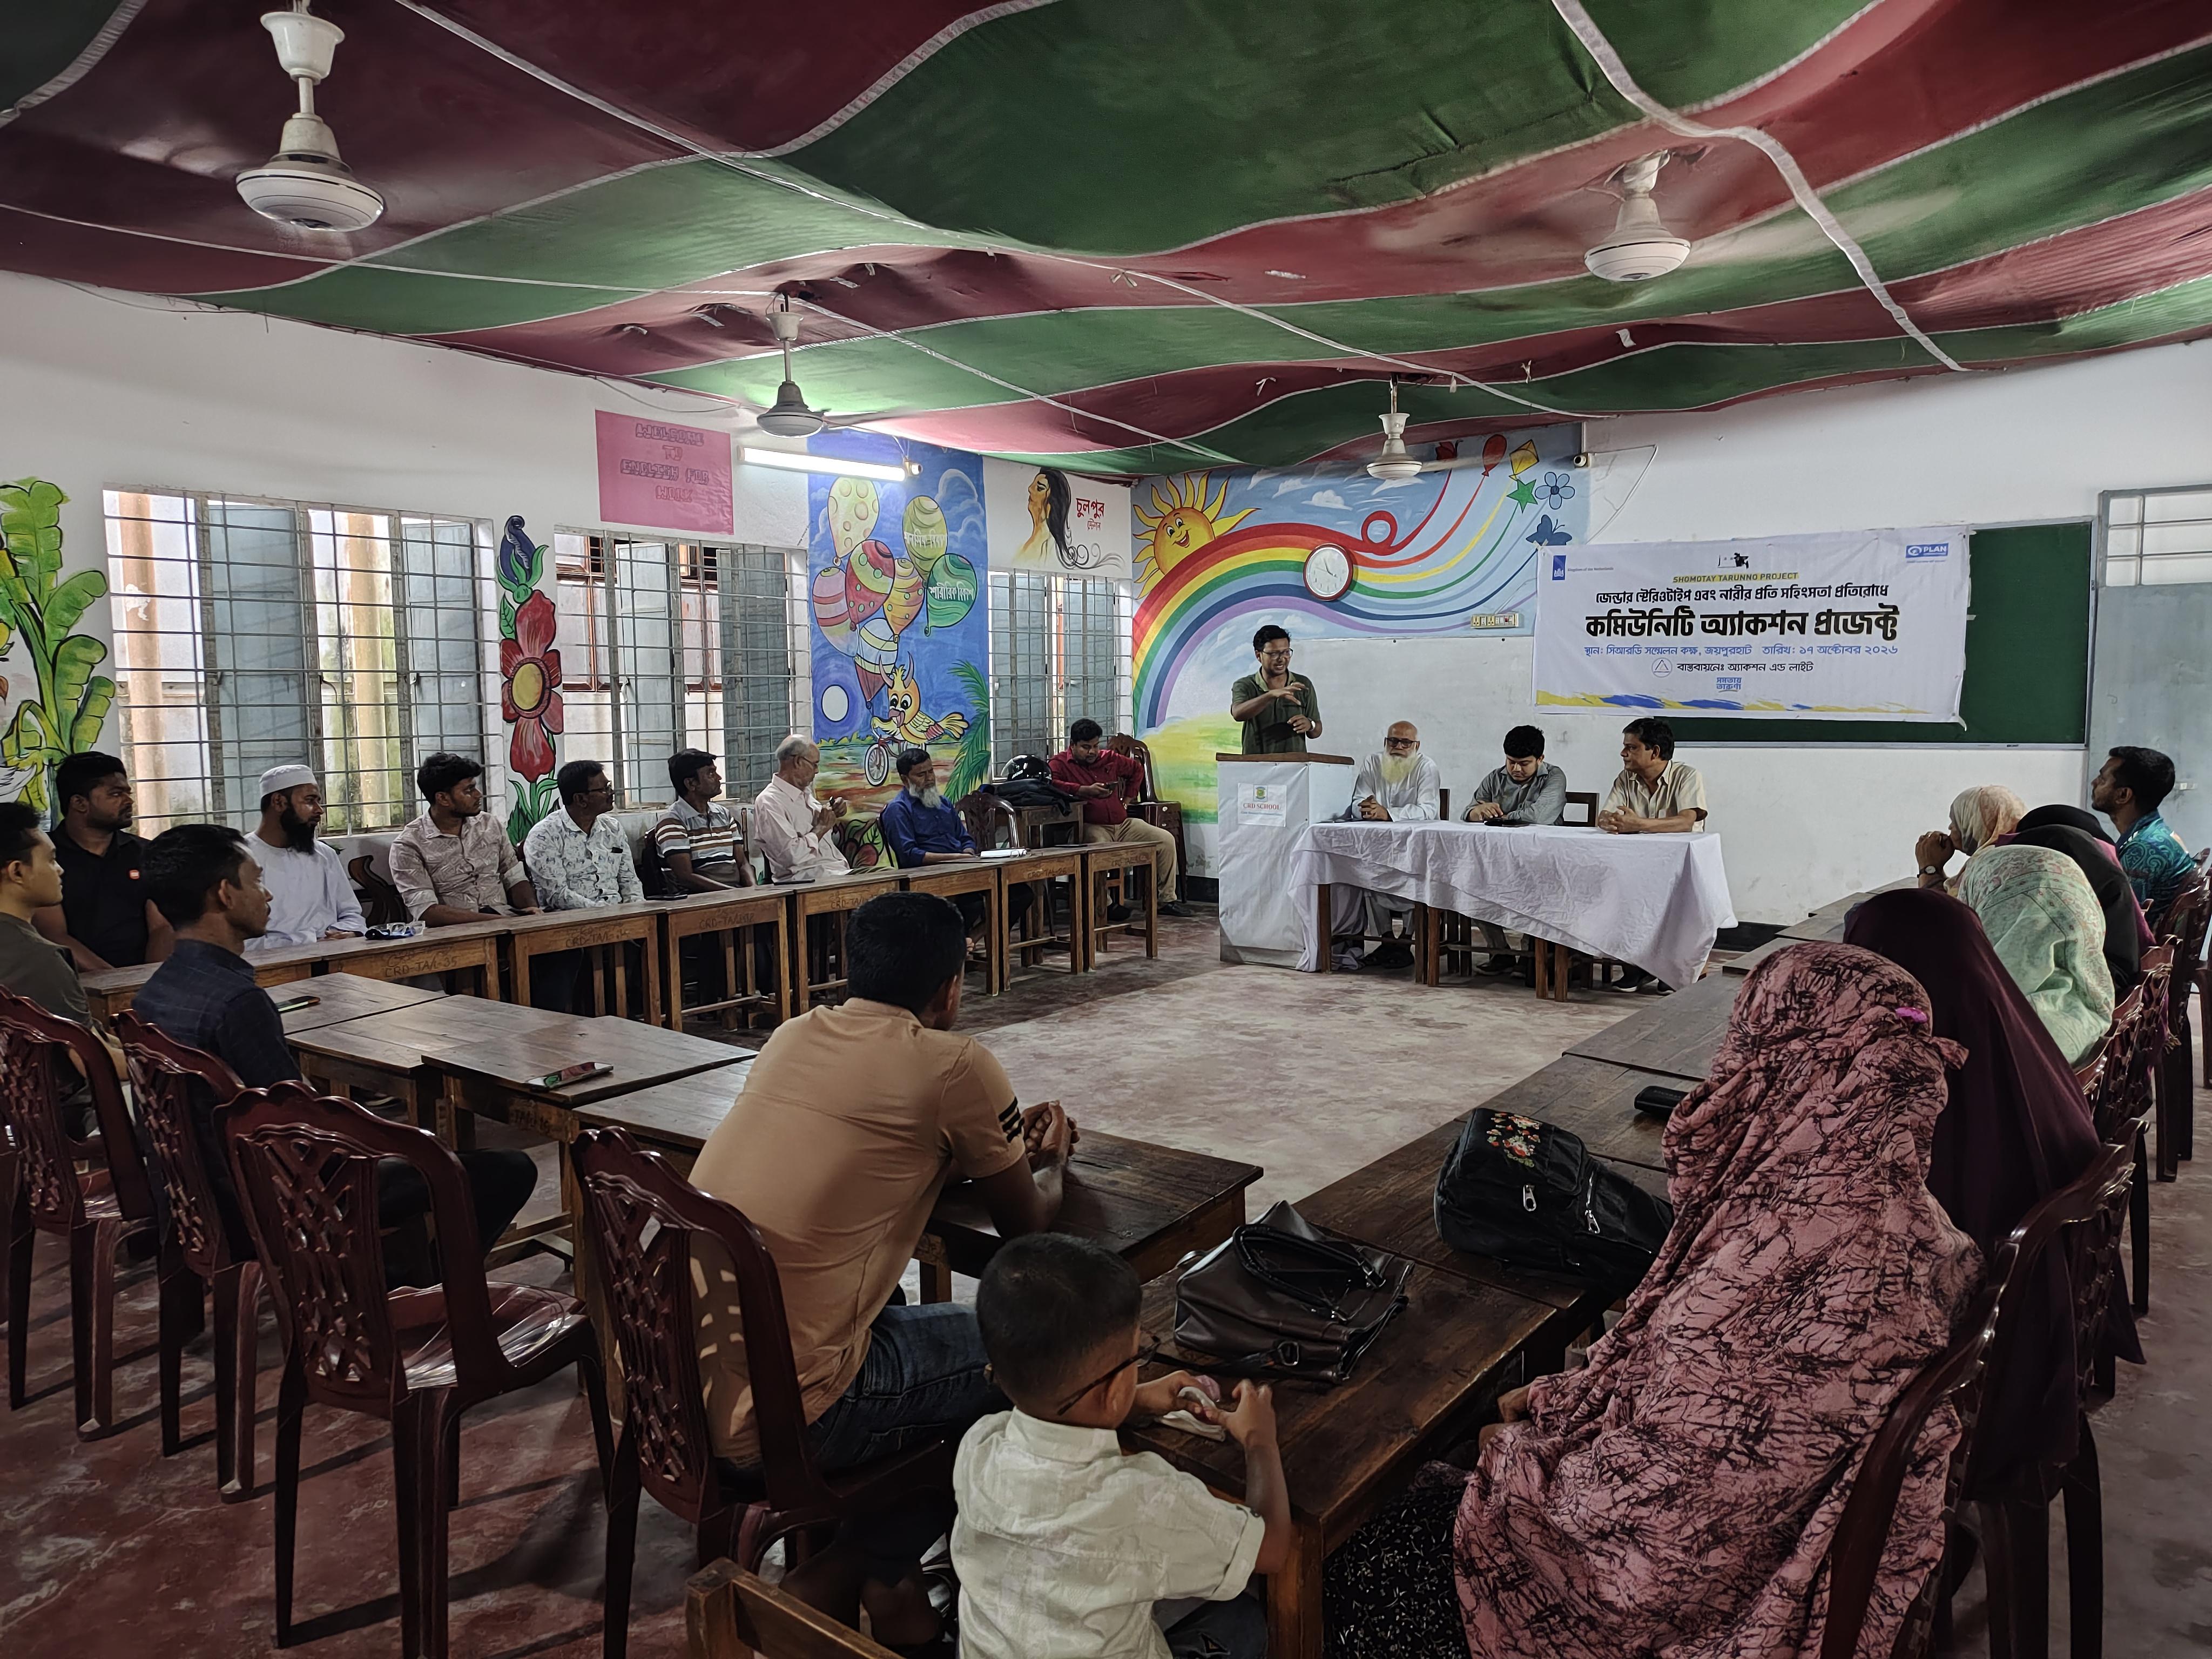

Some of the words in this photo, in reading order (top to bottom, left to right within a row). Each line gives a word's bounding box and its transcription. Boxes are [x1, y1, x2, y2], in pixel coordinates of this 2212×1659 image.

[636, 423, 704, 446] WELCOME
[662, 444, 683, 461] TO
[621, 459, 679, 481] ENGLISH
[686, 468, 709, 485] FOR
[656, 485, 693, 502] WORK
[1719, 574, 1758, 582] TARUNNO
[1761, 572, 1798, 581] PROJECT
[1596, 591, 1634, 604] জেন্ডার
[1694, 590, 1716, 601] এবং
[1719, 584, 1752, 601] নারীর
[1755, 585, 1778, 600] প্রতি
[1781, 584, 1832, 599] সহিংসতা
[1835, 583, 1889, 598] প্রতিরোধে
[1586, 605, 1696, 637] কমিউনিটি
[1700, 610, 1809, 636] অ্যাকশন
[1814, 603, 1900, 641] প্রজেক্ট
[1606, 644, 1642, 655] সিআরডি
[1644, 647, 1678, 655] সম্মেলন
[1704, 644, 1752, 657] জয়পুরহাট
[1799, 646, 1813, 655] ১৭
[1817, 643, 1862, 655] অক্টোবর
[1865, 645, 1898, 655] ২০২৬
[1728, 663, 1766, 672] অ্যাকশন
[1789, 661, 1814, 672] লাইট
